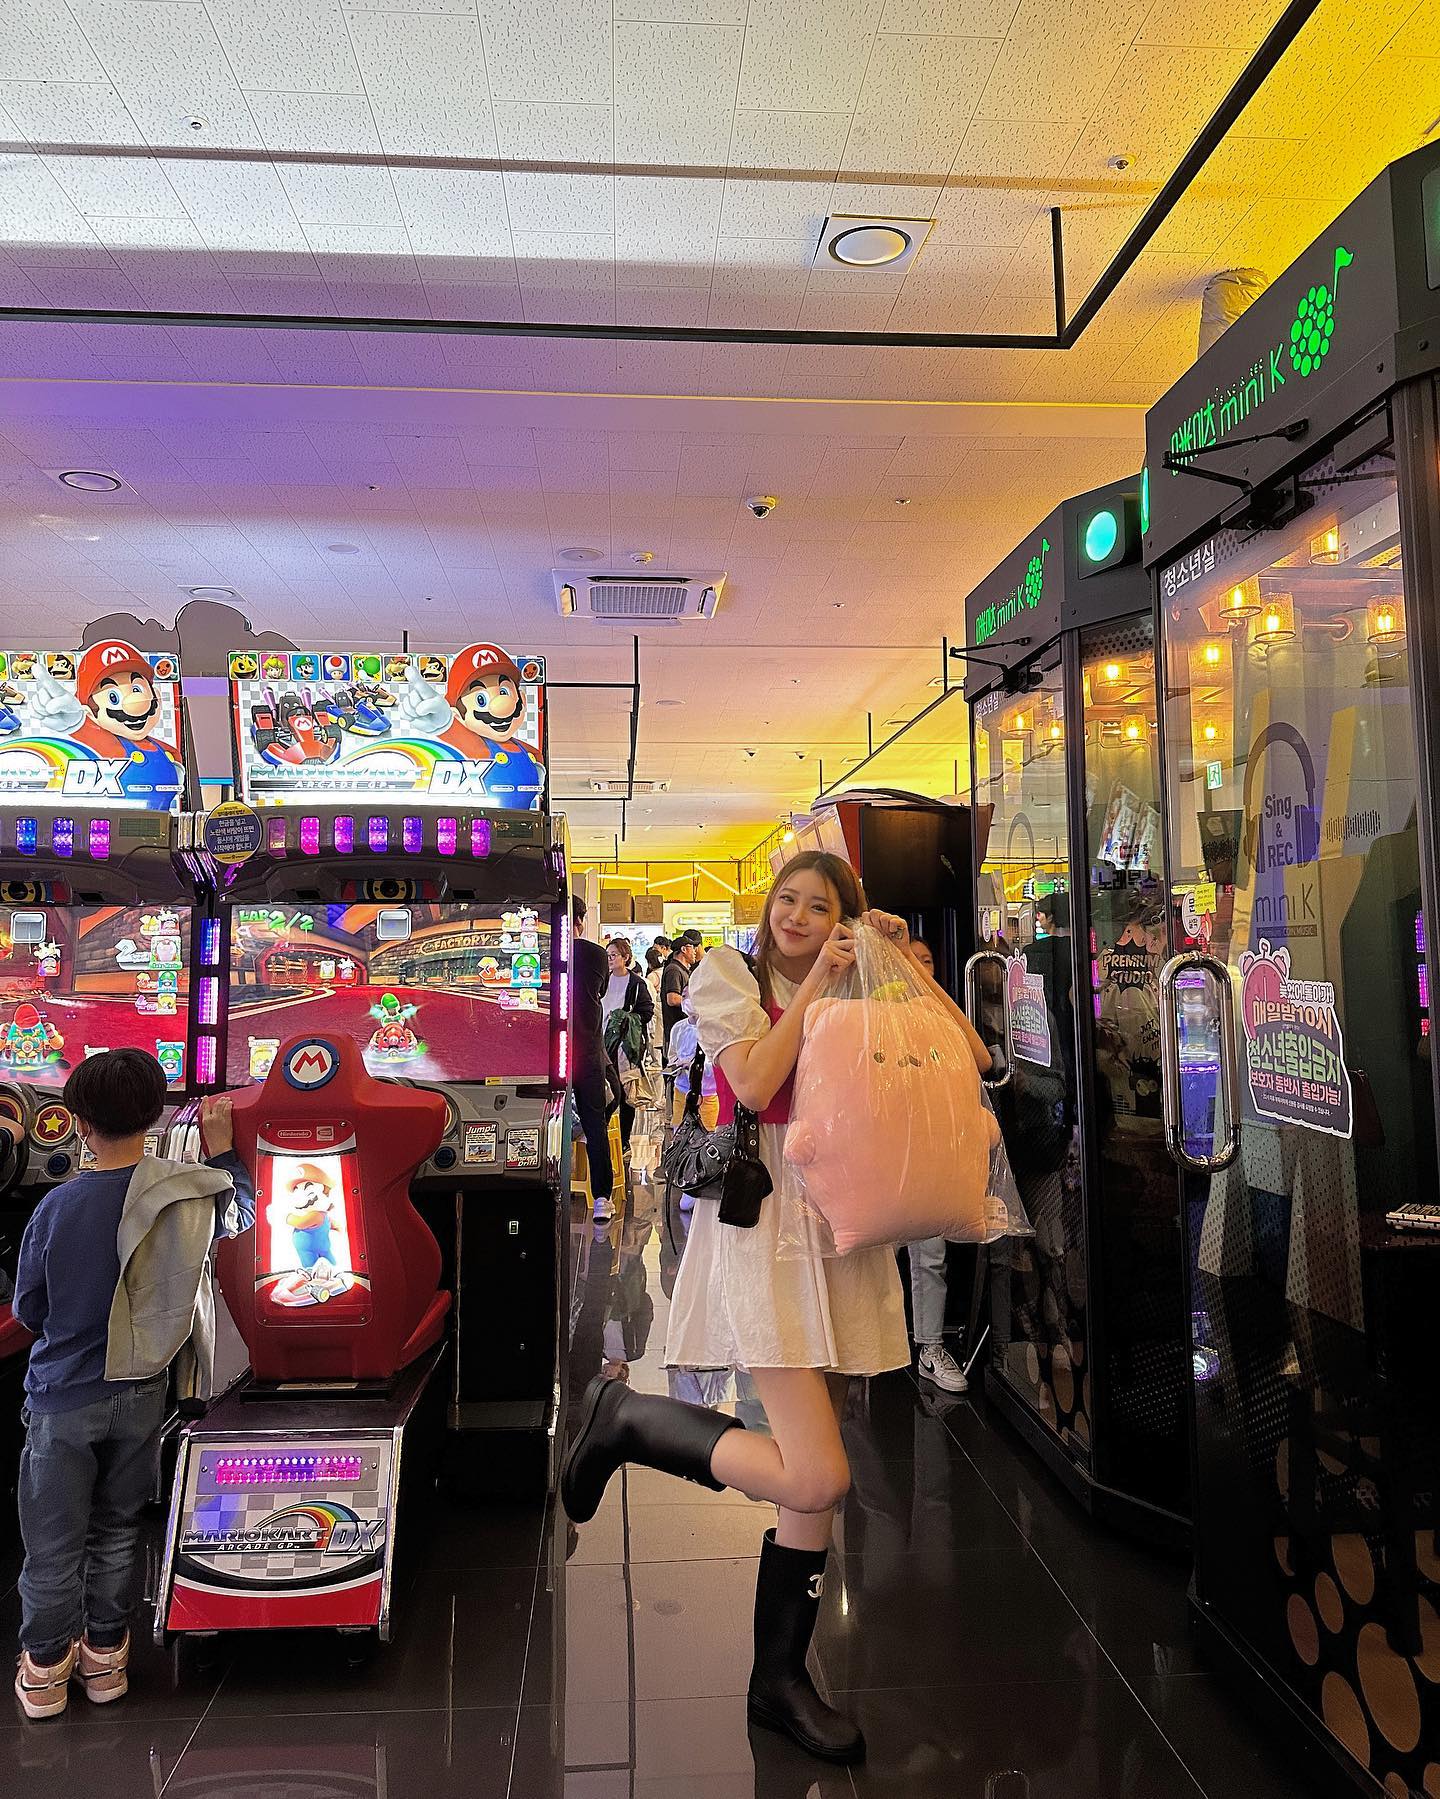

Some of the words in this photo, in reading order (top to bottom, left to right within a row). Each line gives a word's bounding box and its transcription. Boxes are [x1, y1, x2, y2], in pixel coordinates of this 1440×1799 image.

[1219, 373, 1266, 437] mini
[1269, 342, 1287, 394] K
[1164, 540, 1216, 597] 청소년실
[1017, 584, 1026, 613] K
[62, 759, 130, 795] DX
[428, 759, 494, 795] DX
[1264, 793, 1292, 819] Sing
[1275, 822, 1283, 838] &
[1267, 841, 1294, 869] REC
[1301, 882, 1316, 920] K
[239, 909, 270, 921] LAP
[267, 910, 315, 931] 2/2
[433, 933, 492, 951] FACTORY
[1103, 953, 1160, 968] PREMIUM
[1110, 970, 1154, 985] STUDIO
[1251, 1069, 1274, 1091] 보호자
[1275, 1074, 1301, 1097] 동반시
[1301, 1080, 1342, 1106] 출입가능!
[466, 1124, 497, 1135] Jump!!
[217, 1543, 269, 1551] ARCADE
[325, 1520, 385, 1554] DX
